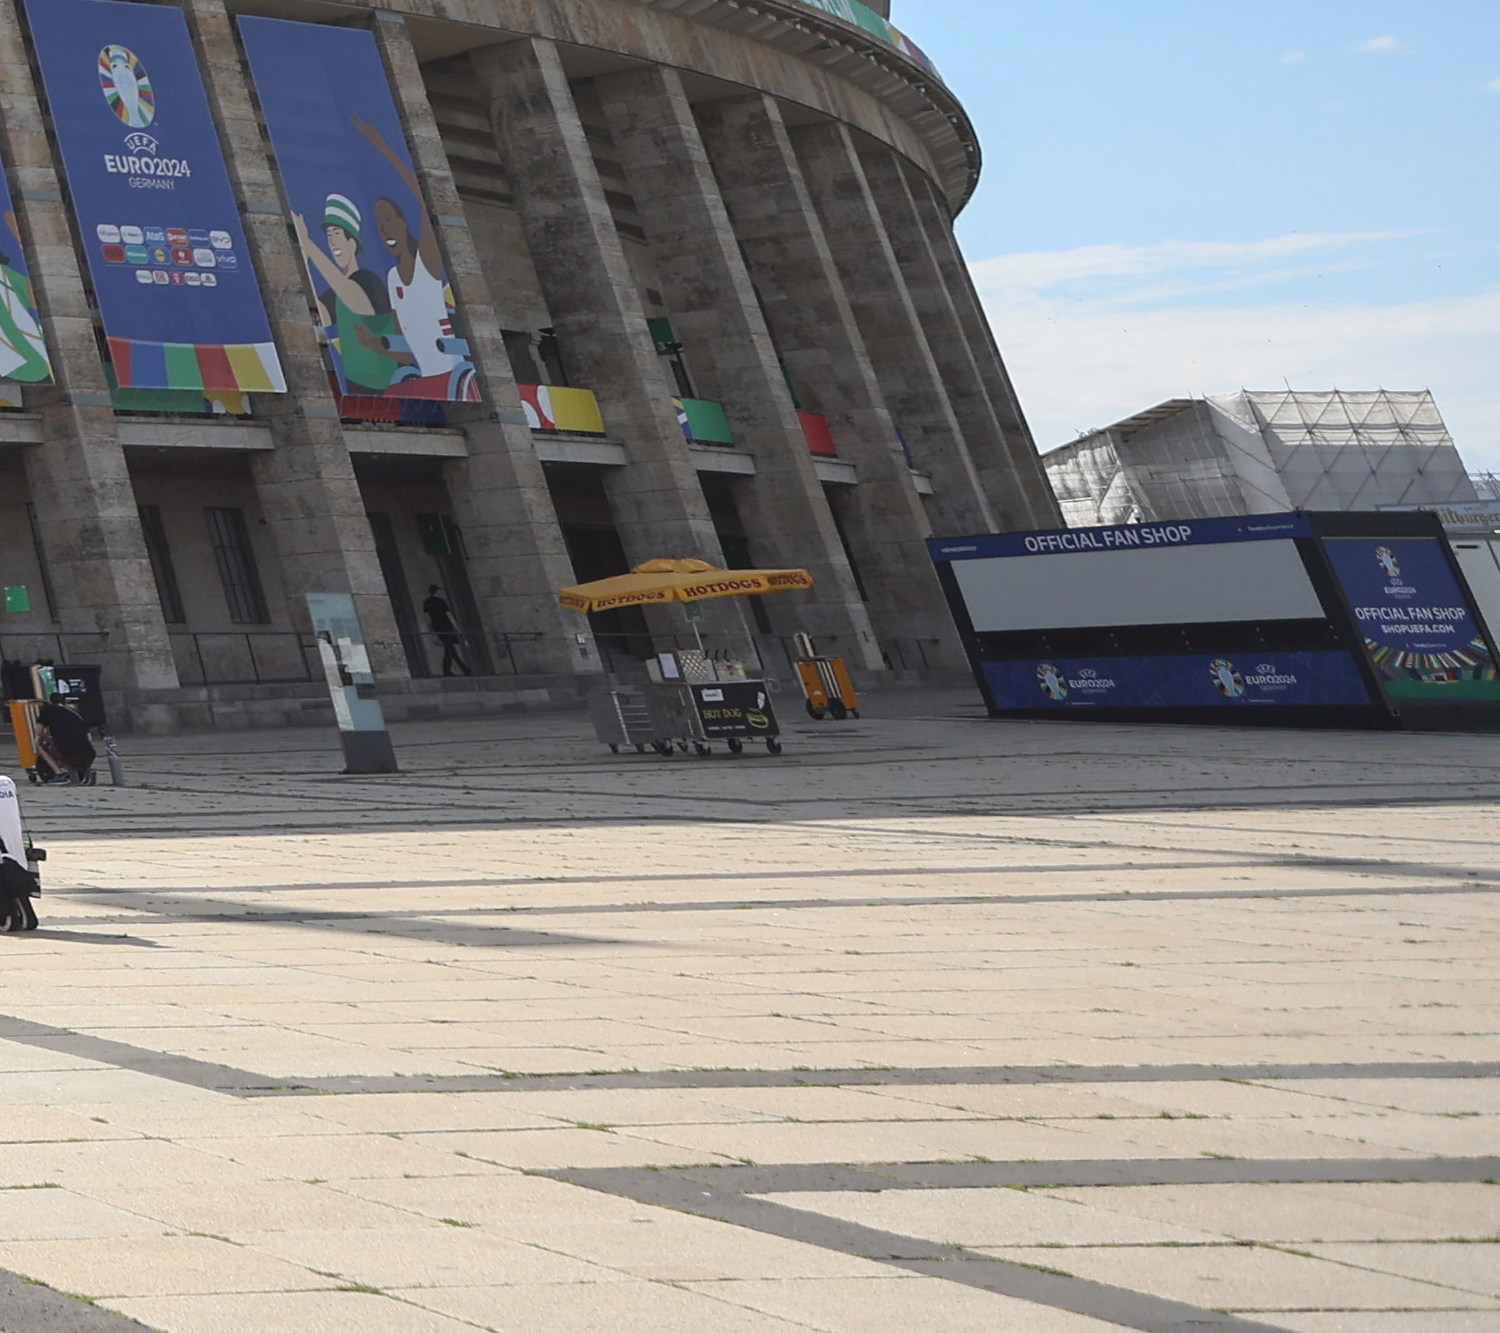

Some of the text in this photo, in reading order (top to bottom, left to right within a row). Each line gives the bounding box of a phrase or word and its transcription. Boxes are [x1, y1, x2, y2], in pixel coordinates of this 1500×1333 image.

[126, 135, 157, 153] UEFA
[103, 154, 191, 178] EURO2024
[128, 177, 175, 190] GERMANY
[1024, 525, 1192, 553] OFFICIAL FAN SHOP
[683, 578, 762, 597] HOTDOGS
[597, 591, 665, 608] HOTDOGS
[1354, 607, 1466, 620] OFFICIAL FAN SHOP
